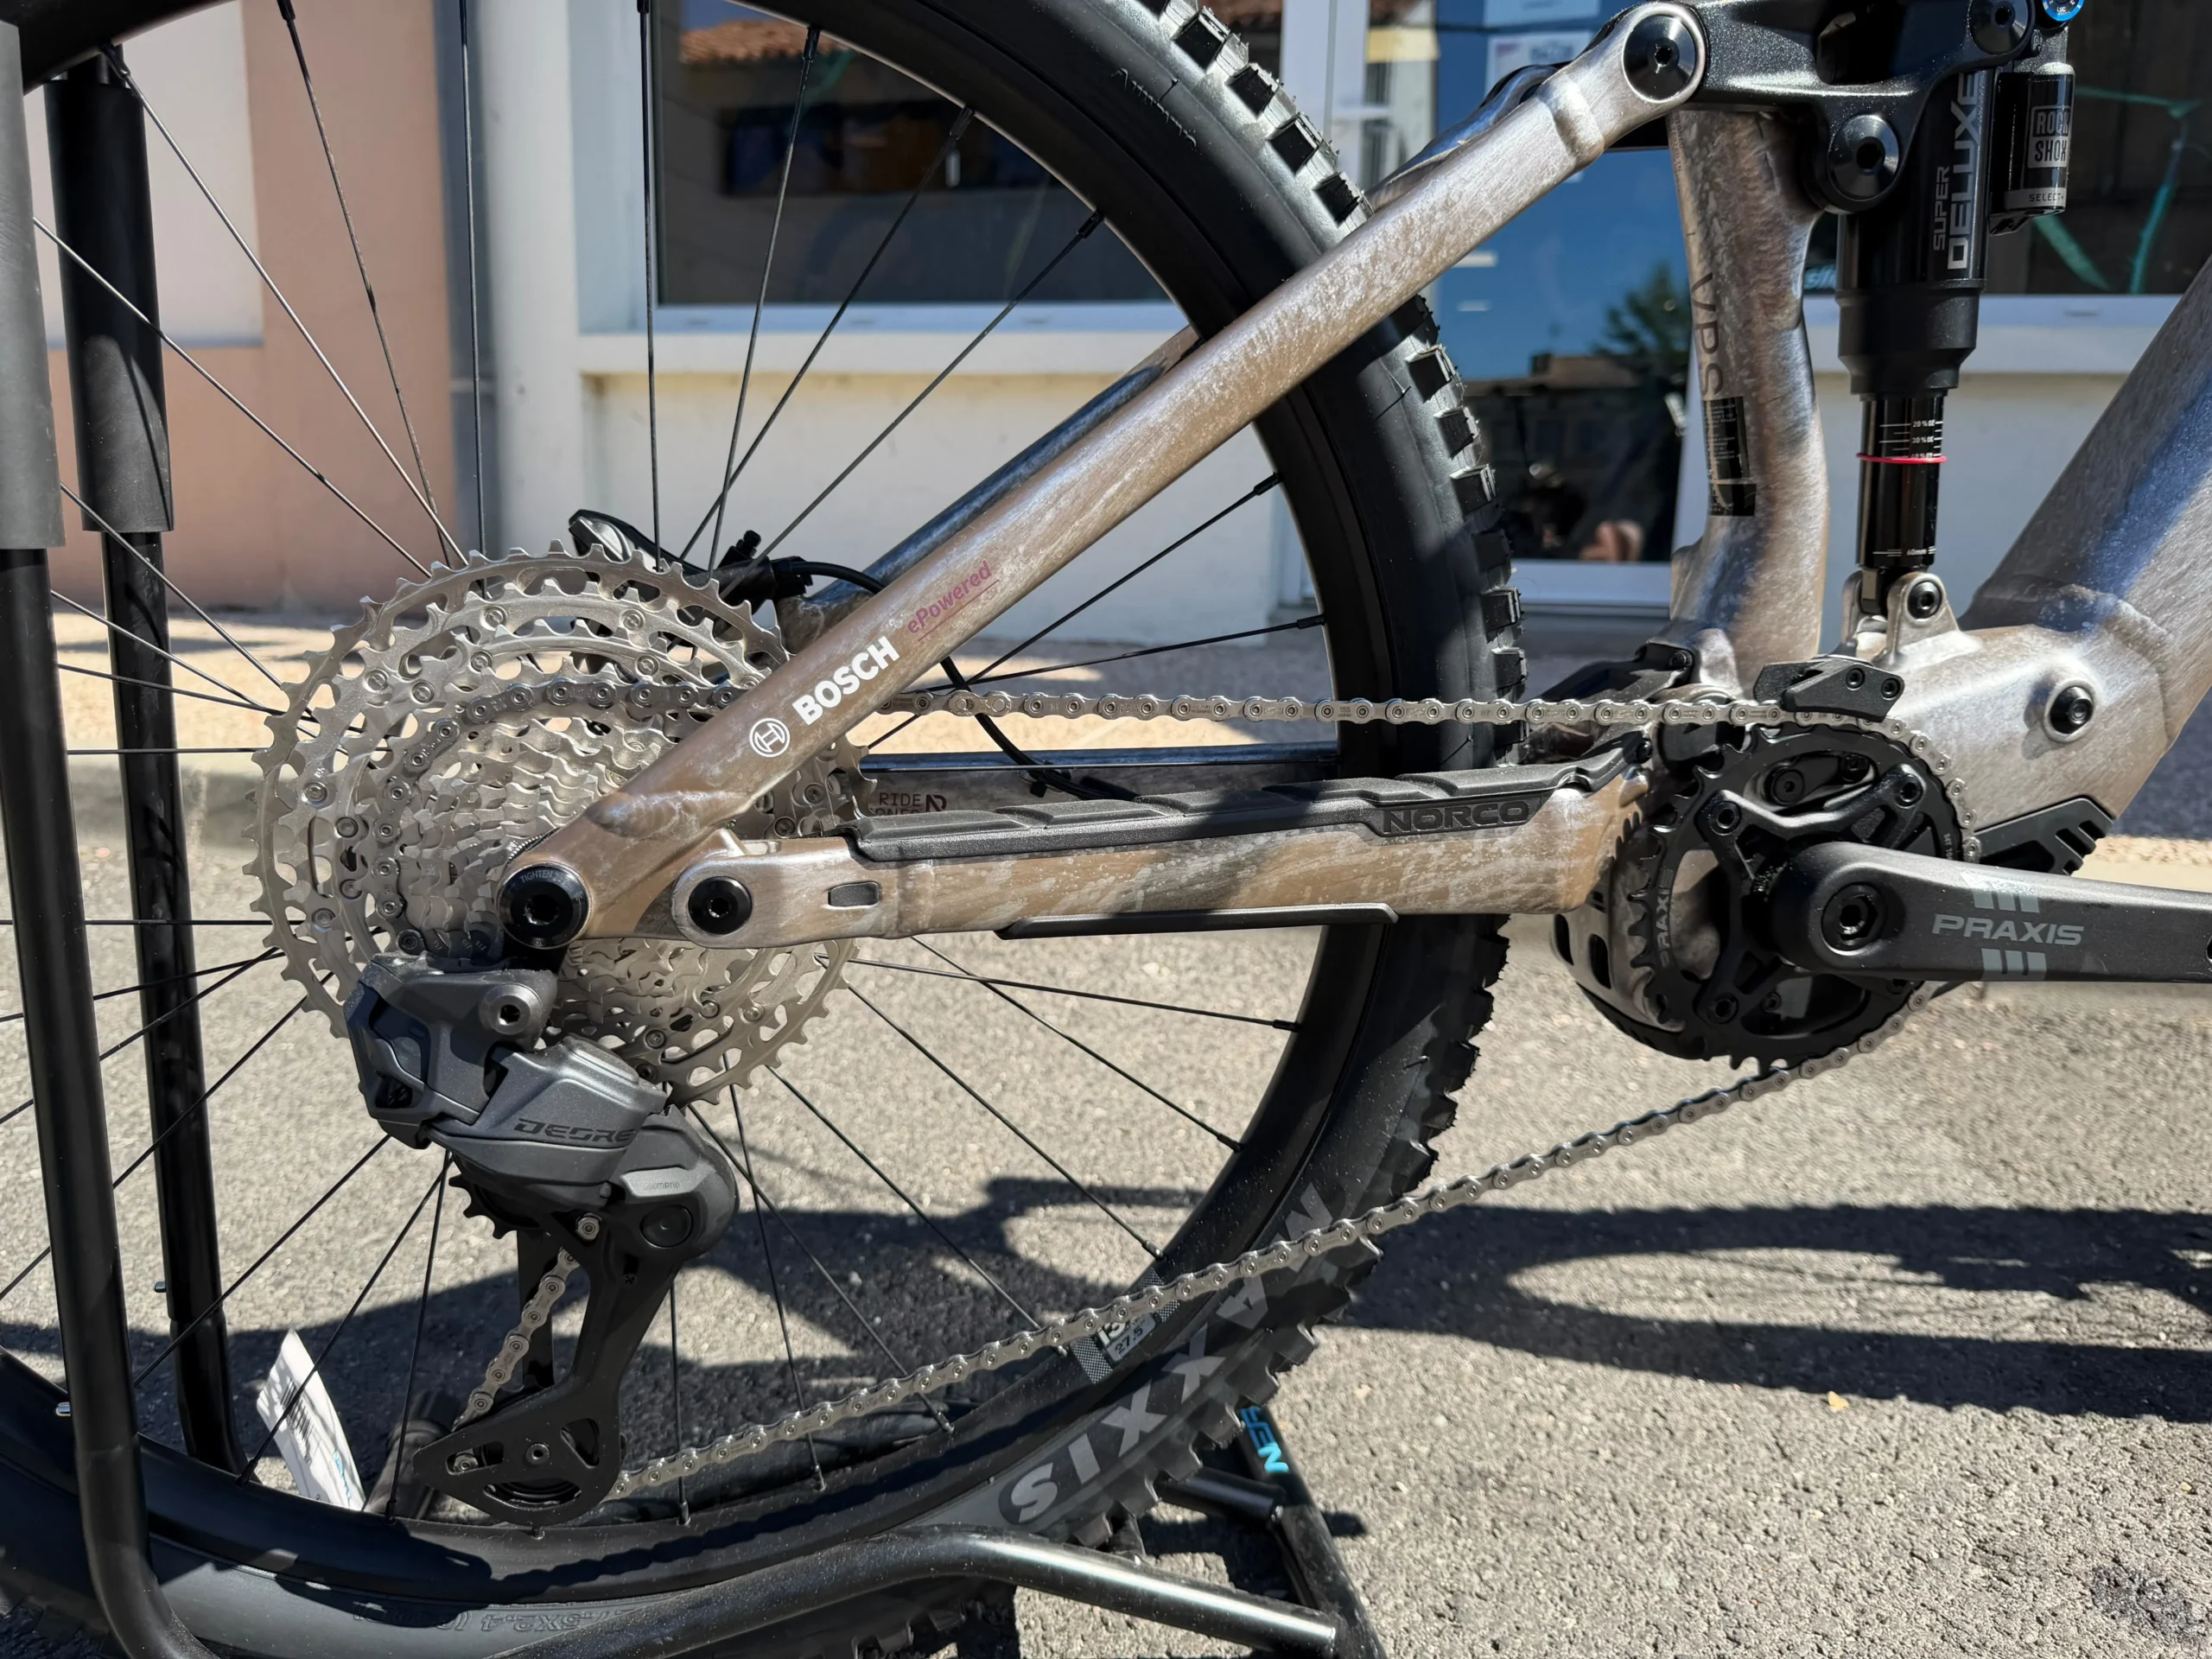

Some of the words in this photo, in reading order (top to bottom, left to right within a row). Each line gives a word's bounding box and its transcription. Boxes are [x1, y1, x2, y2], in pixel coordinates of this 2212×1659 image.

[2036, 111, 2069, 134] ROCK
[2034, 139, 2066, 162] SHOX
[1947, 73, 1980, 270] DELUXE
[1933, 166, 1949, 251] SUPER
[907, 560, 993, 634] ePowered
[791, 636, 900, 726] BOSCH
[879, 792, 922, 807] RIDE
[1382, 800, 1529, 835] NORCO
[1931, 913, 2085, 946] PRAXIS
[514, 1118, 636, 1142] DEORE
